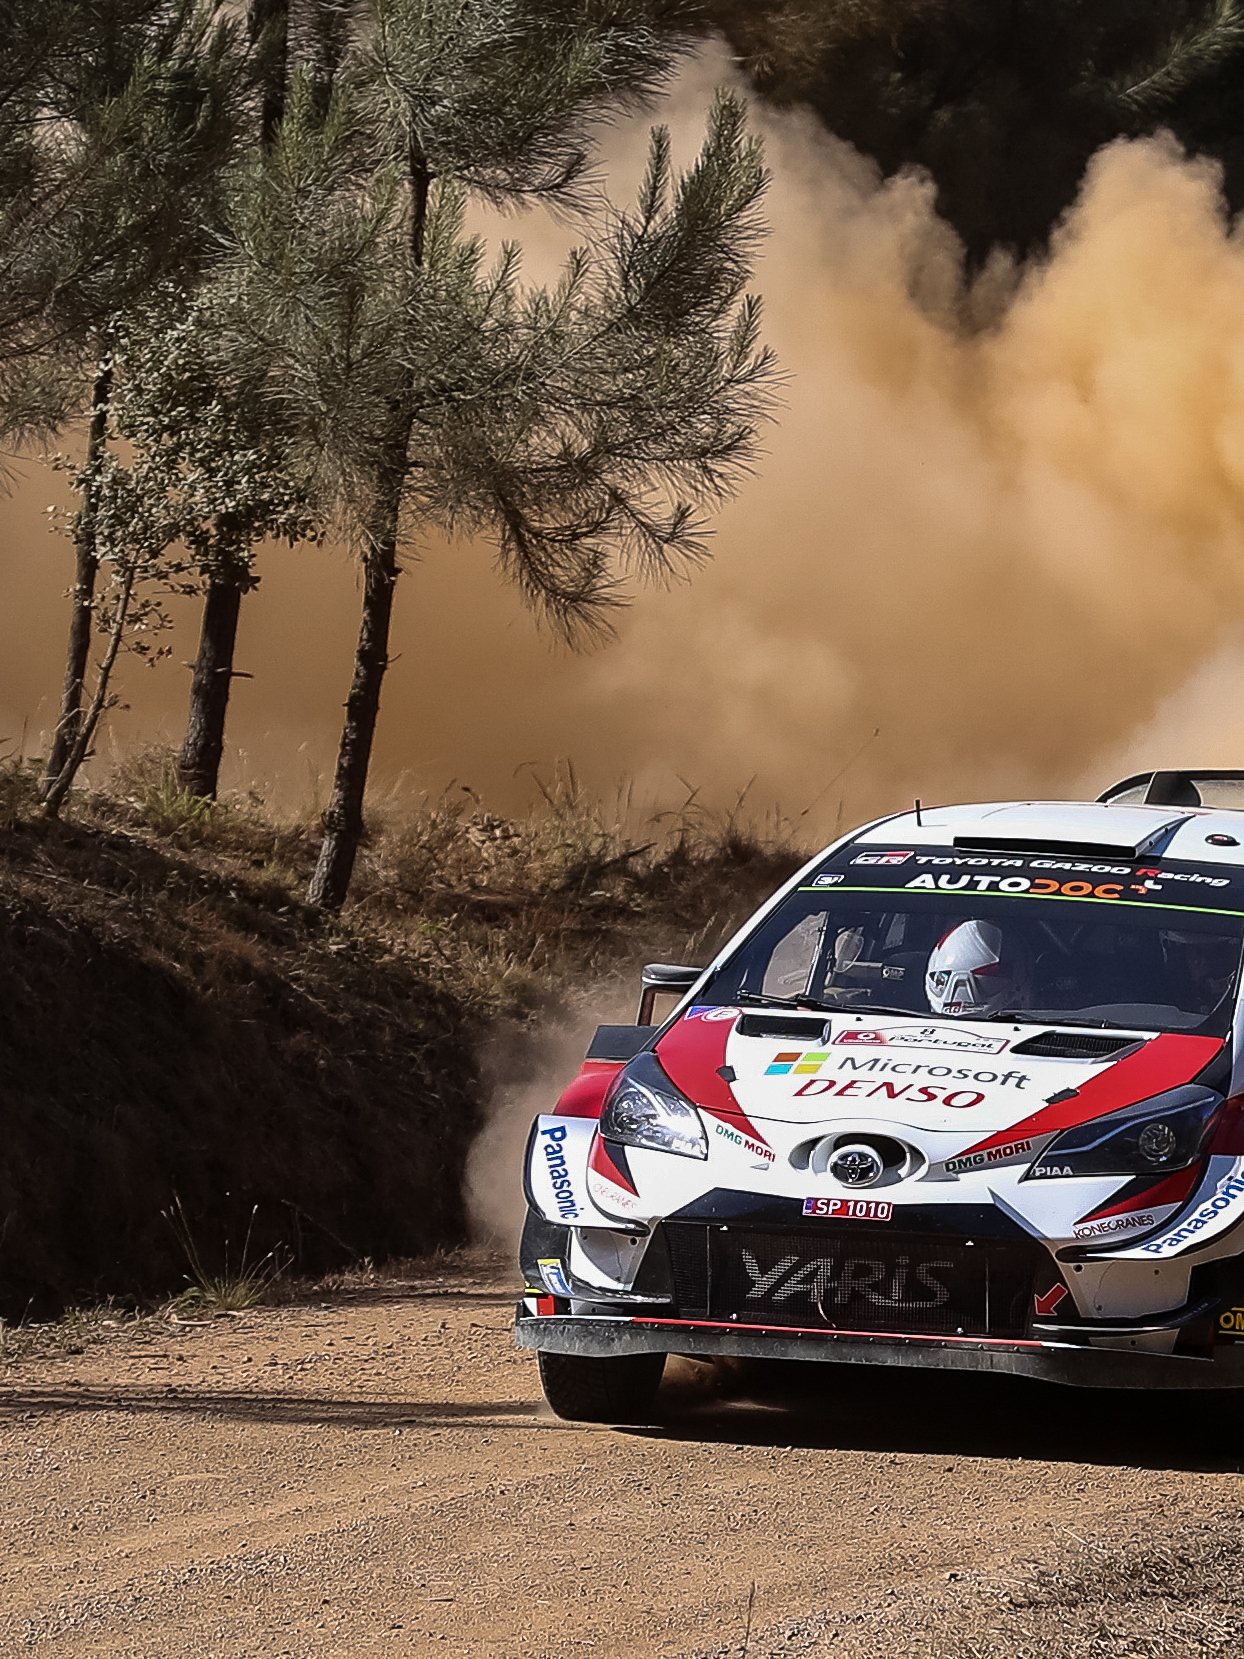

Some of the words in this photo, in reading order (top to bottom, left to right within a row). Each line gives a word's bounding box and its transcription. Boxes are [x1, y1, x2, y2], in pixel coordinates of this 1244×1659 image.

[904, 873, 1124, 898] AUTODOC
[915, 856, 1024, 867] TOYOTA
[1029, 859, 1132, 875] GAZOO
[1136, 868, 1231, 887] Racing
[838, 1056, 1032, 1090] Microsoft
[792, 1079, 986, 1109] DENSO
[715, 1124, 742, 1146] DMG
[743, 1139, 776, 1163] MORI
[944, 1153, 985, 1173] DMG
[986, 1140, 1032, 1161] MORI
[540, 1125, 585, 1220] Panasonic
[1035, 1166, 1074, 1177] PIAA
[815, 1199, 841, 1215] SP
[847, 1201, 889, 1218] 1010
[1073, 1214, 1155, 1240] KONECRANES
